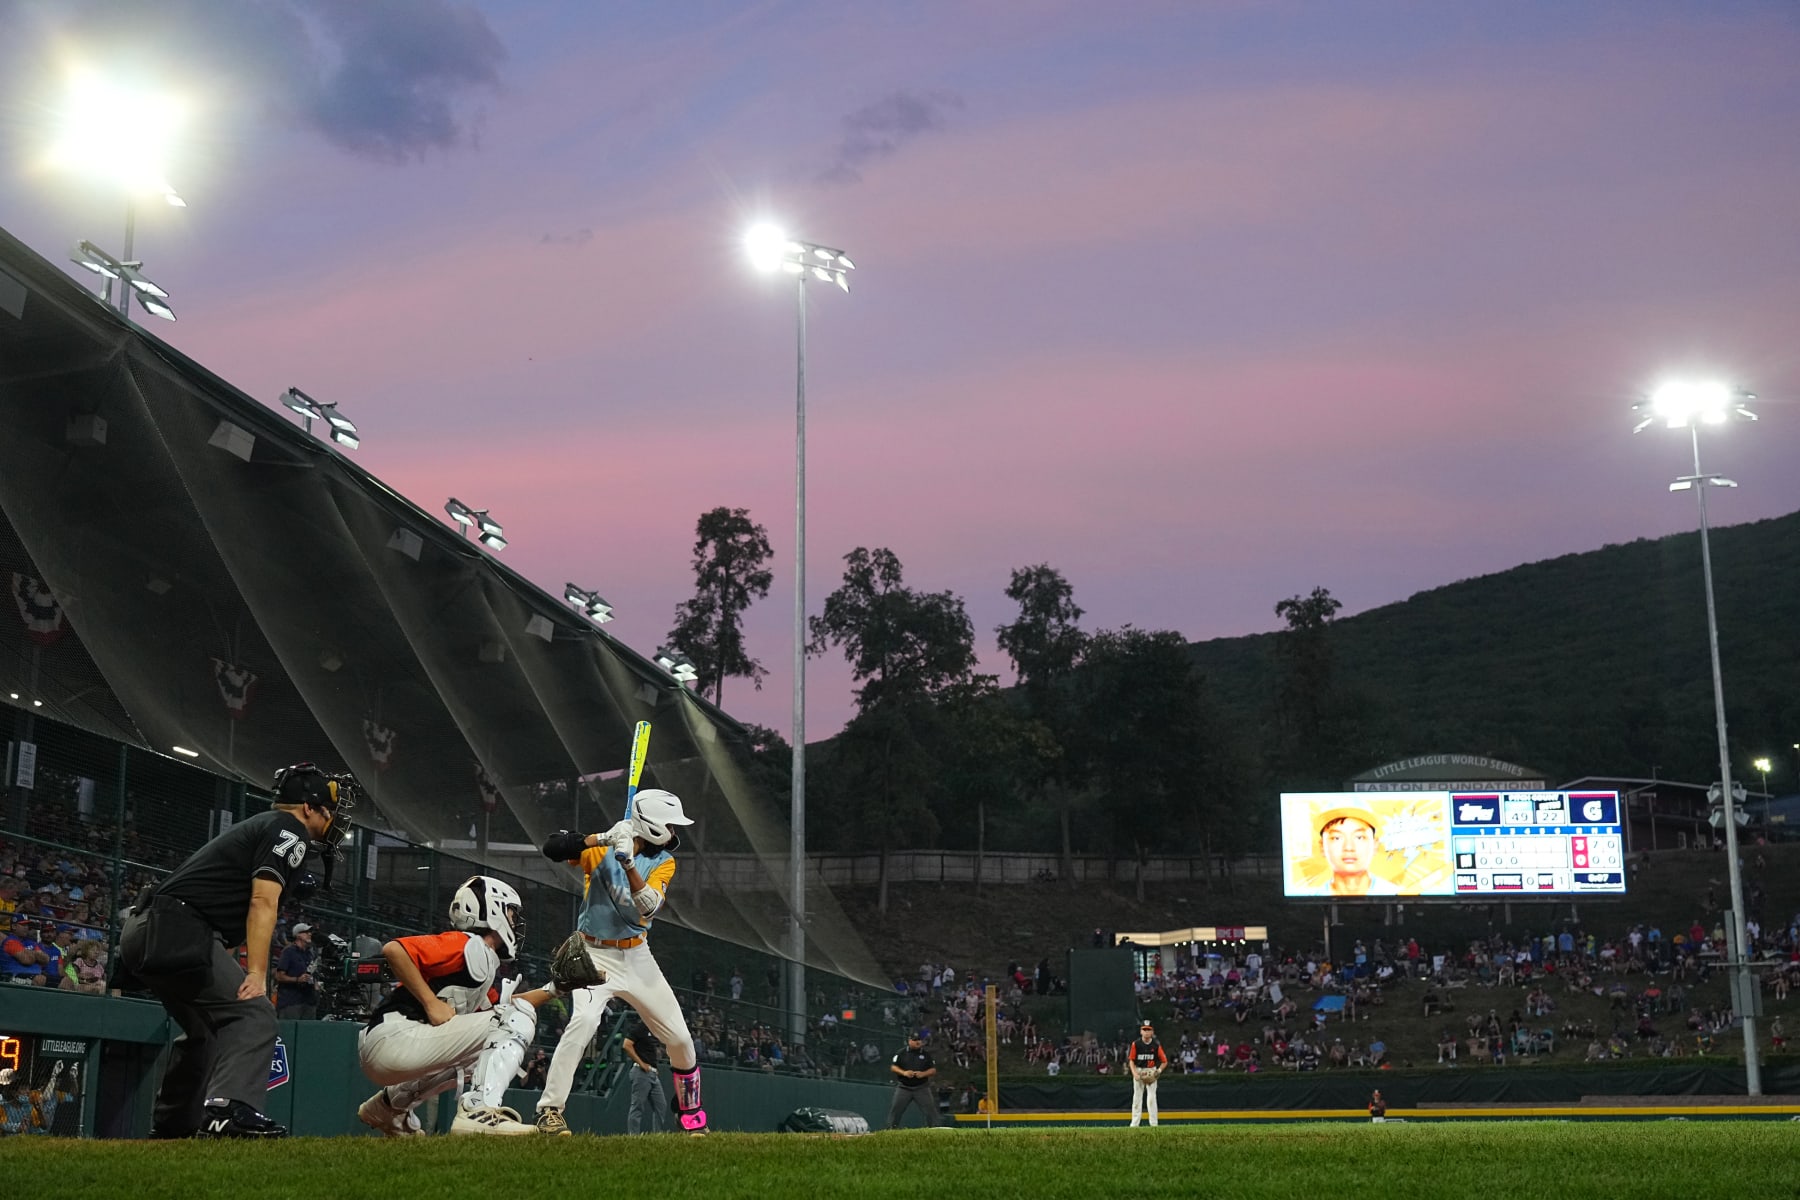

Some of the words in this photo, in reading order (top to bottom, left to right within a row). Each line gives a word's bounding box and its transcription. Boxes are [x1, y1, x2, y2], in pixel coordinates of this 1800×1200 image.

[1374, 762, 1406, 779] LITTLE
[1408, 755, 1447, 768] LEAGUE
[1451, 755, 1487, 767] WORLD
[1489, 757, 1523, 777] SERIES
[1356, 783, 1423, 791] EASTON
[1428, 782, 1543, 791] FOUNDATIONS
[1512, 812, 1528, 821] 49
[1542, 812, 1558, 821] 22
[272, 829, 307, 868] 79
[1480, 856, 1488, 865] 0
[1495, 856, 1503, 865] 0
[1510, 856, 1518, 865] 0
[1575, 854, 1586, 866] 0
[1592, 856, 1600, 865] 0
[1608, 855, 1616, 864] 0
[1481, 877, 1489, 886] 0
[1526, 876, 1535, 886] 0
[357, 964, 379, 974] ESPN
[1, 1039, 20, 1071] 9
